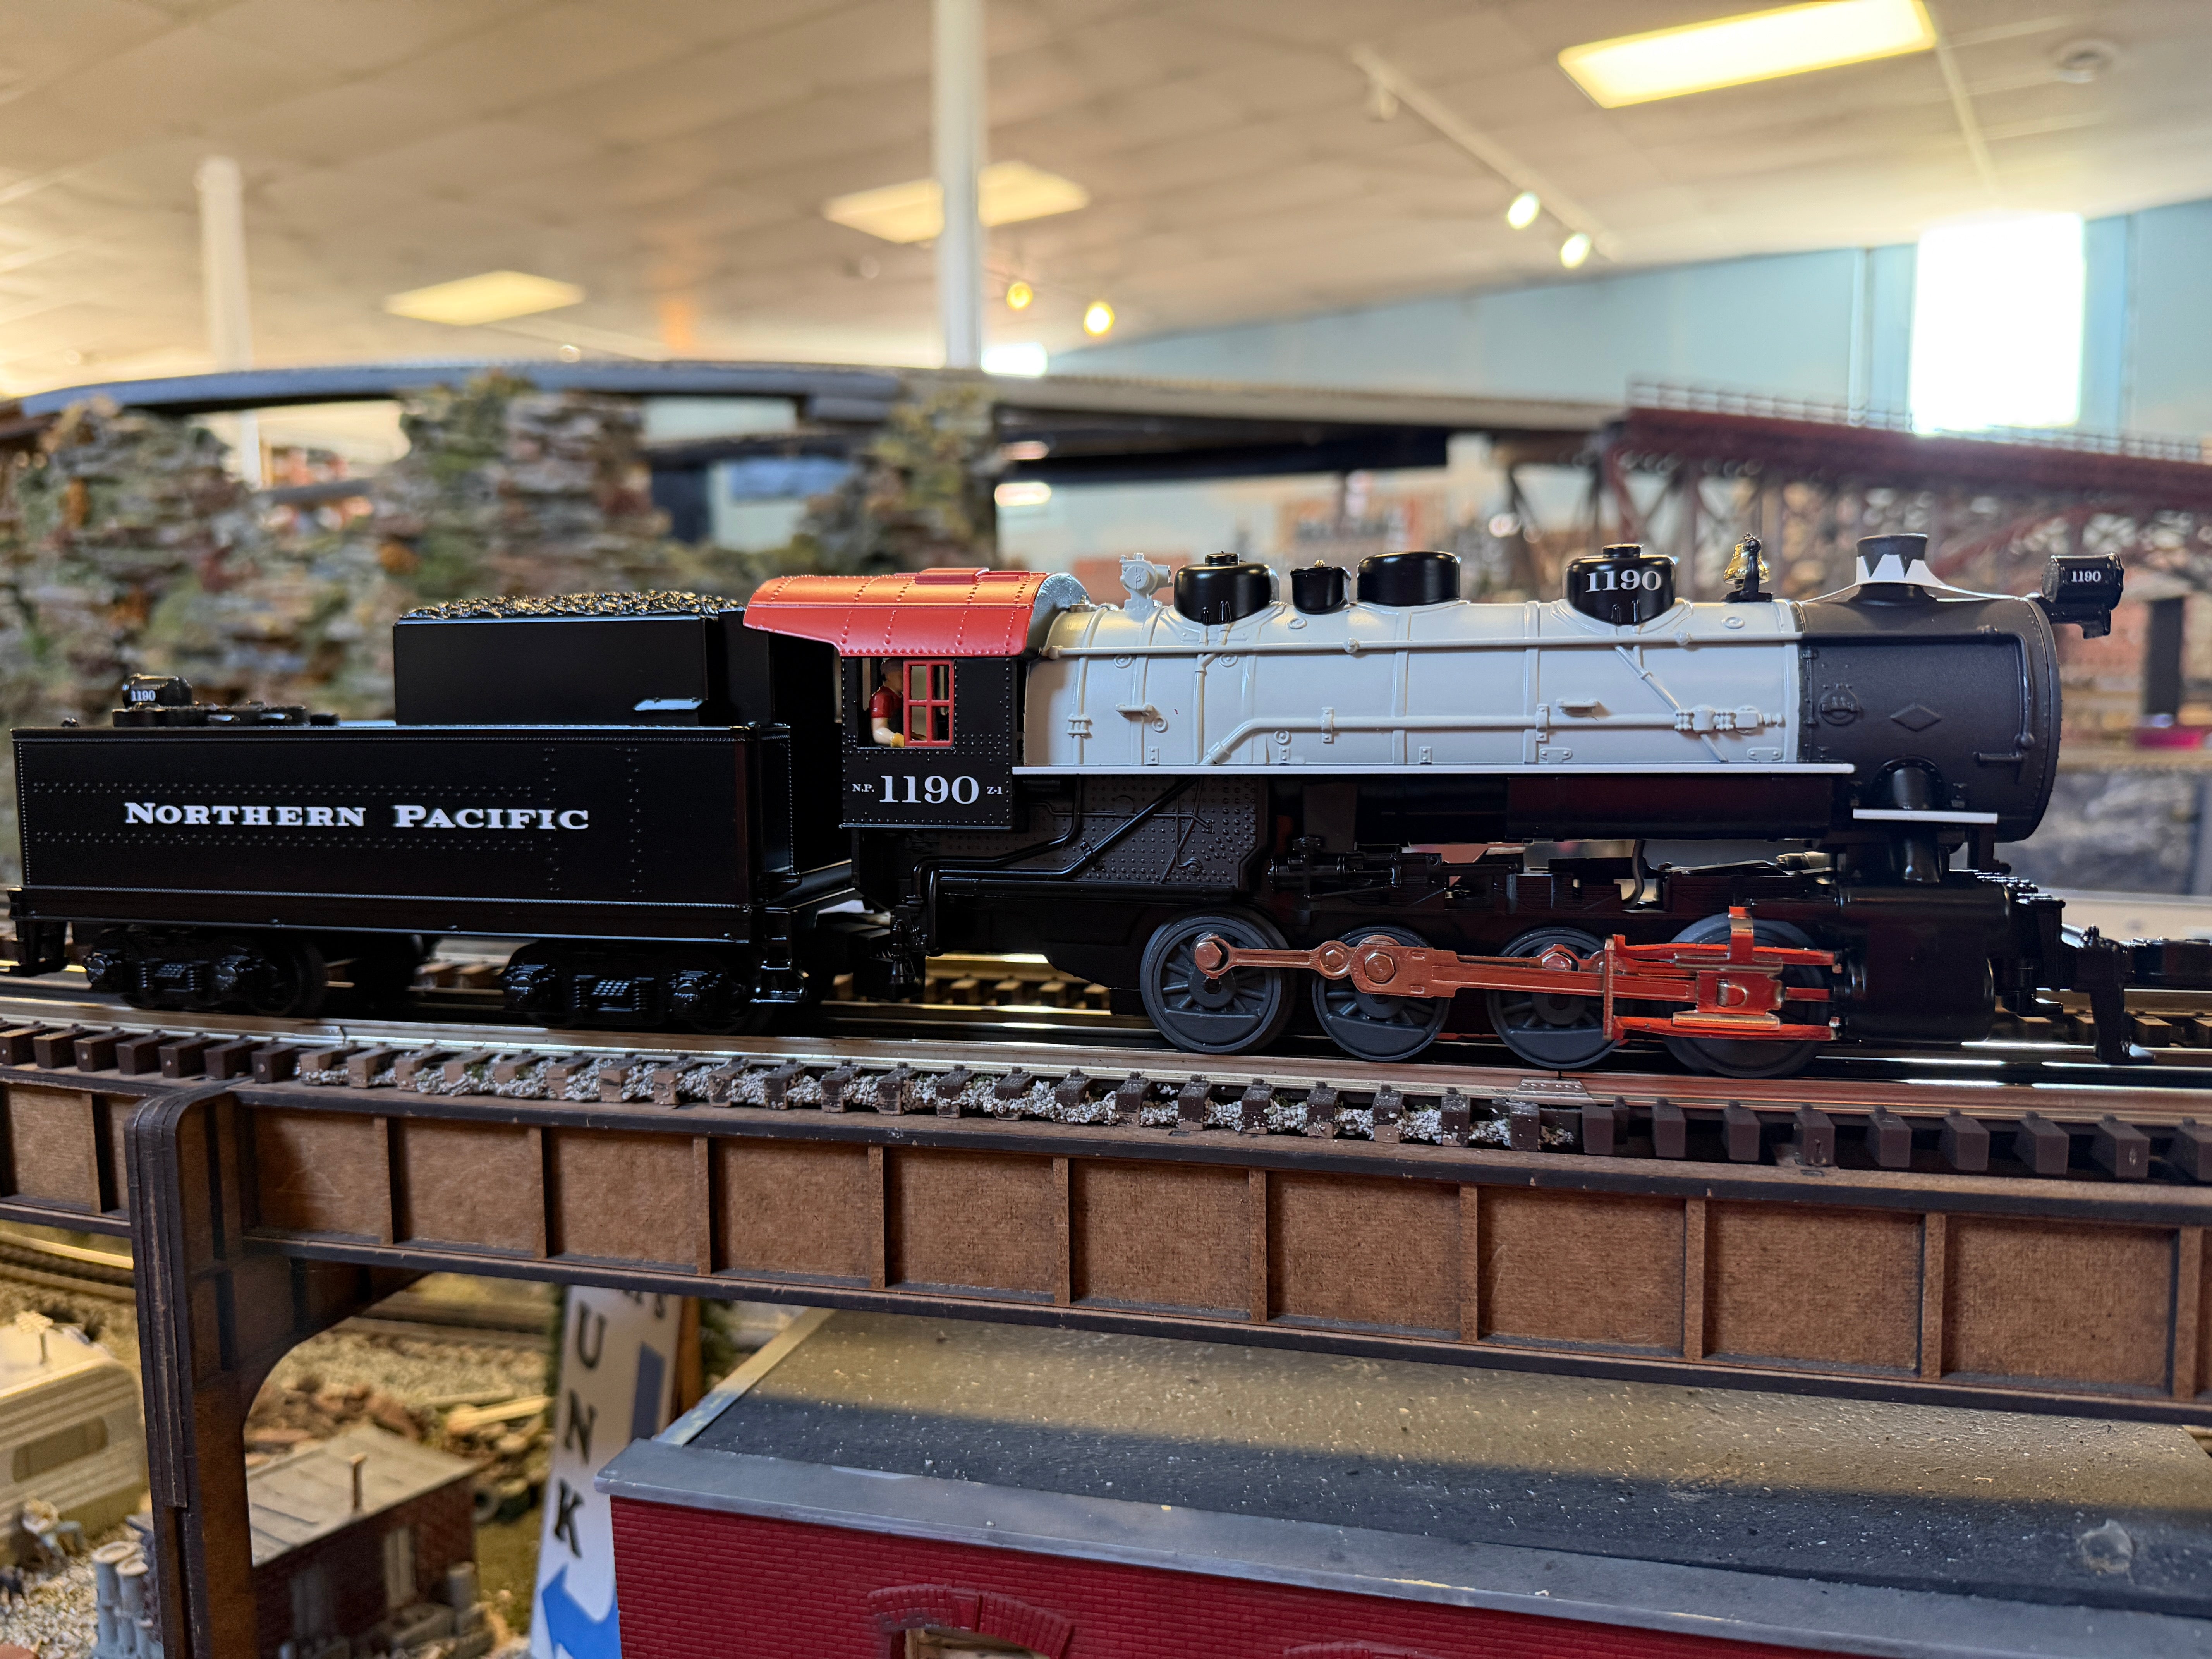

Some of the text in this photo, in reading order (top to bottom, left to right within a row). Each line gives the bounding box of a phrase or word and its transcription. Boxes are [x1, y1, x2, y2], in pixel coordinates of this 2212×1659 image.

[1585, 569, 1661, 592] 1190
[2071, 570, 2101, 582] 1190
[852, 783, 875, 793] N.P.
[879, 775, 979, 804] 1190
[124, 802, 589, 830] NORTHERN PACIFIC
